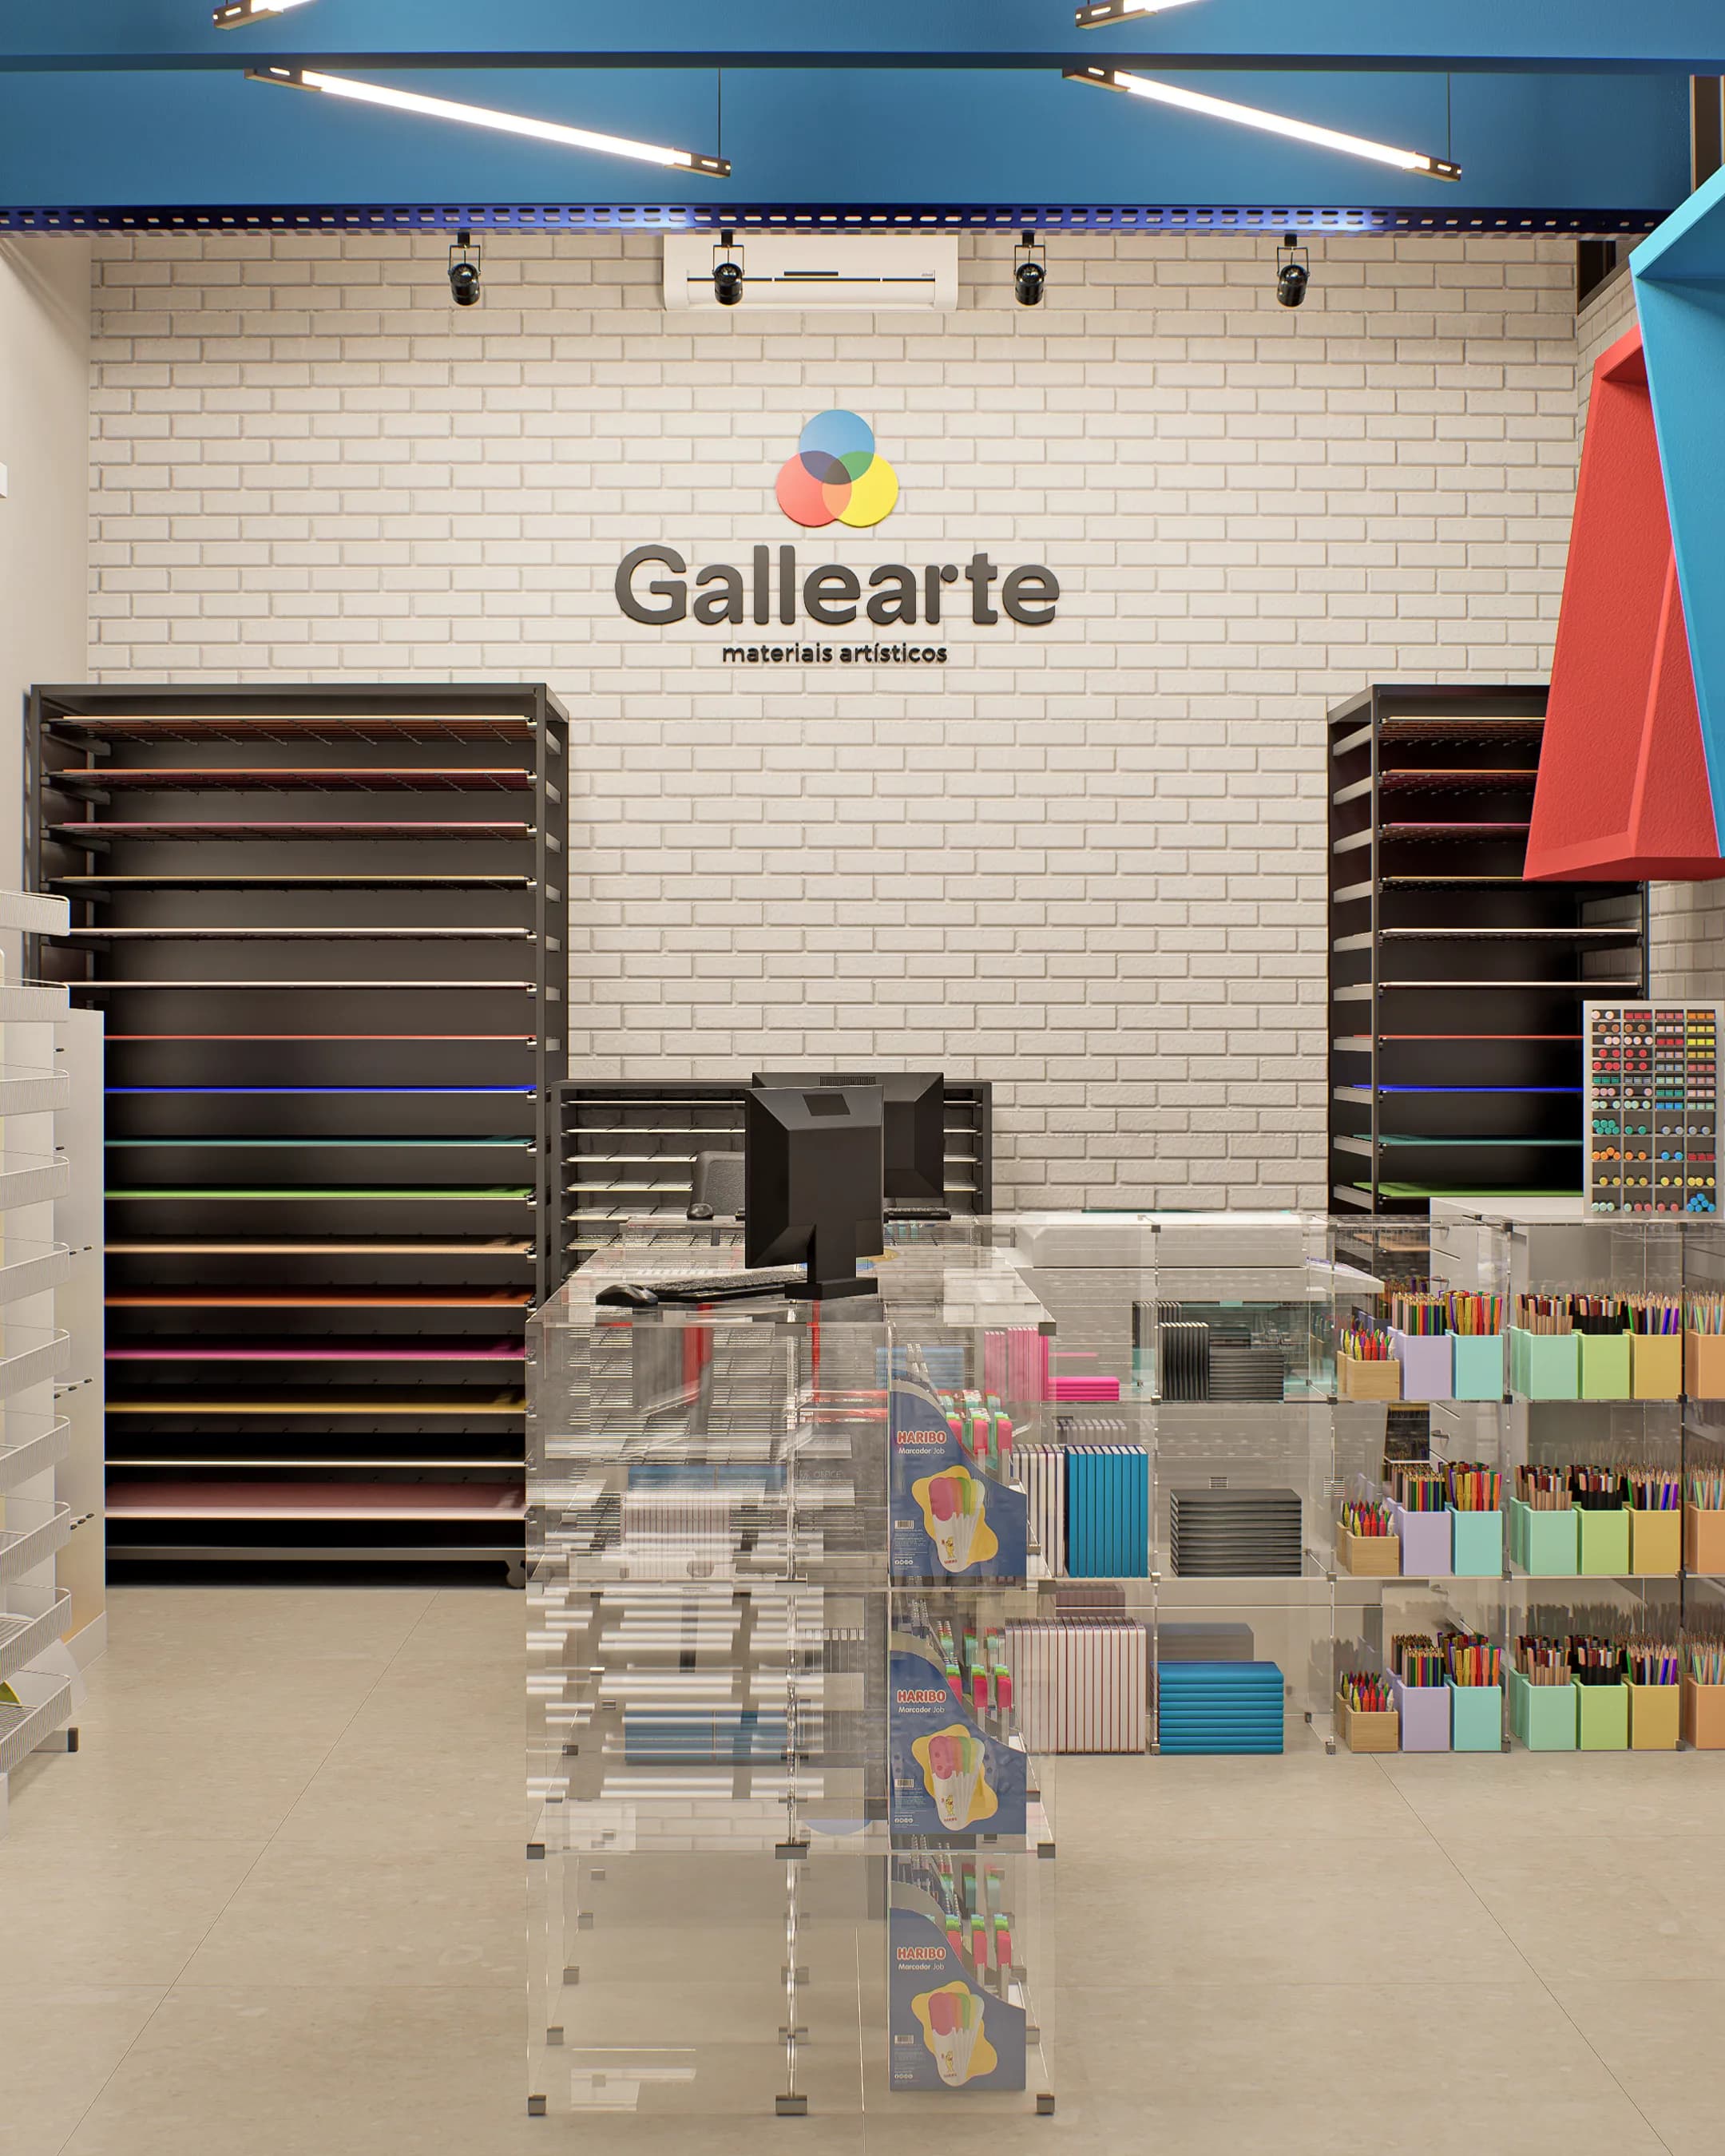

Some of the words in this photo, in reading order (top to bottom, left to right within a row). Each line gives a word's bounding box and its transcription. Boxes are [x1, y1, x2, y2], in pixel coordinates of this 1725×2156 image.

[614, 544, 1061, 625] Gallearte
[722, 642, 833, 664] materiais
[839, 641, 948, 664] artísticos
[897, 1430, 947, 1445] HARIBO
[897, 1689, 946, 1703] HARIBO
[897, 1947, 946, 1960] HARIBO
